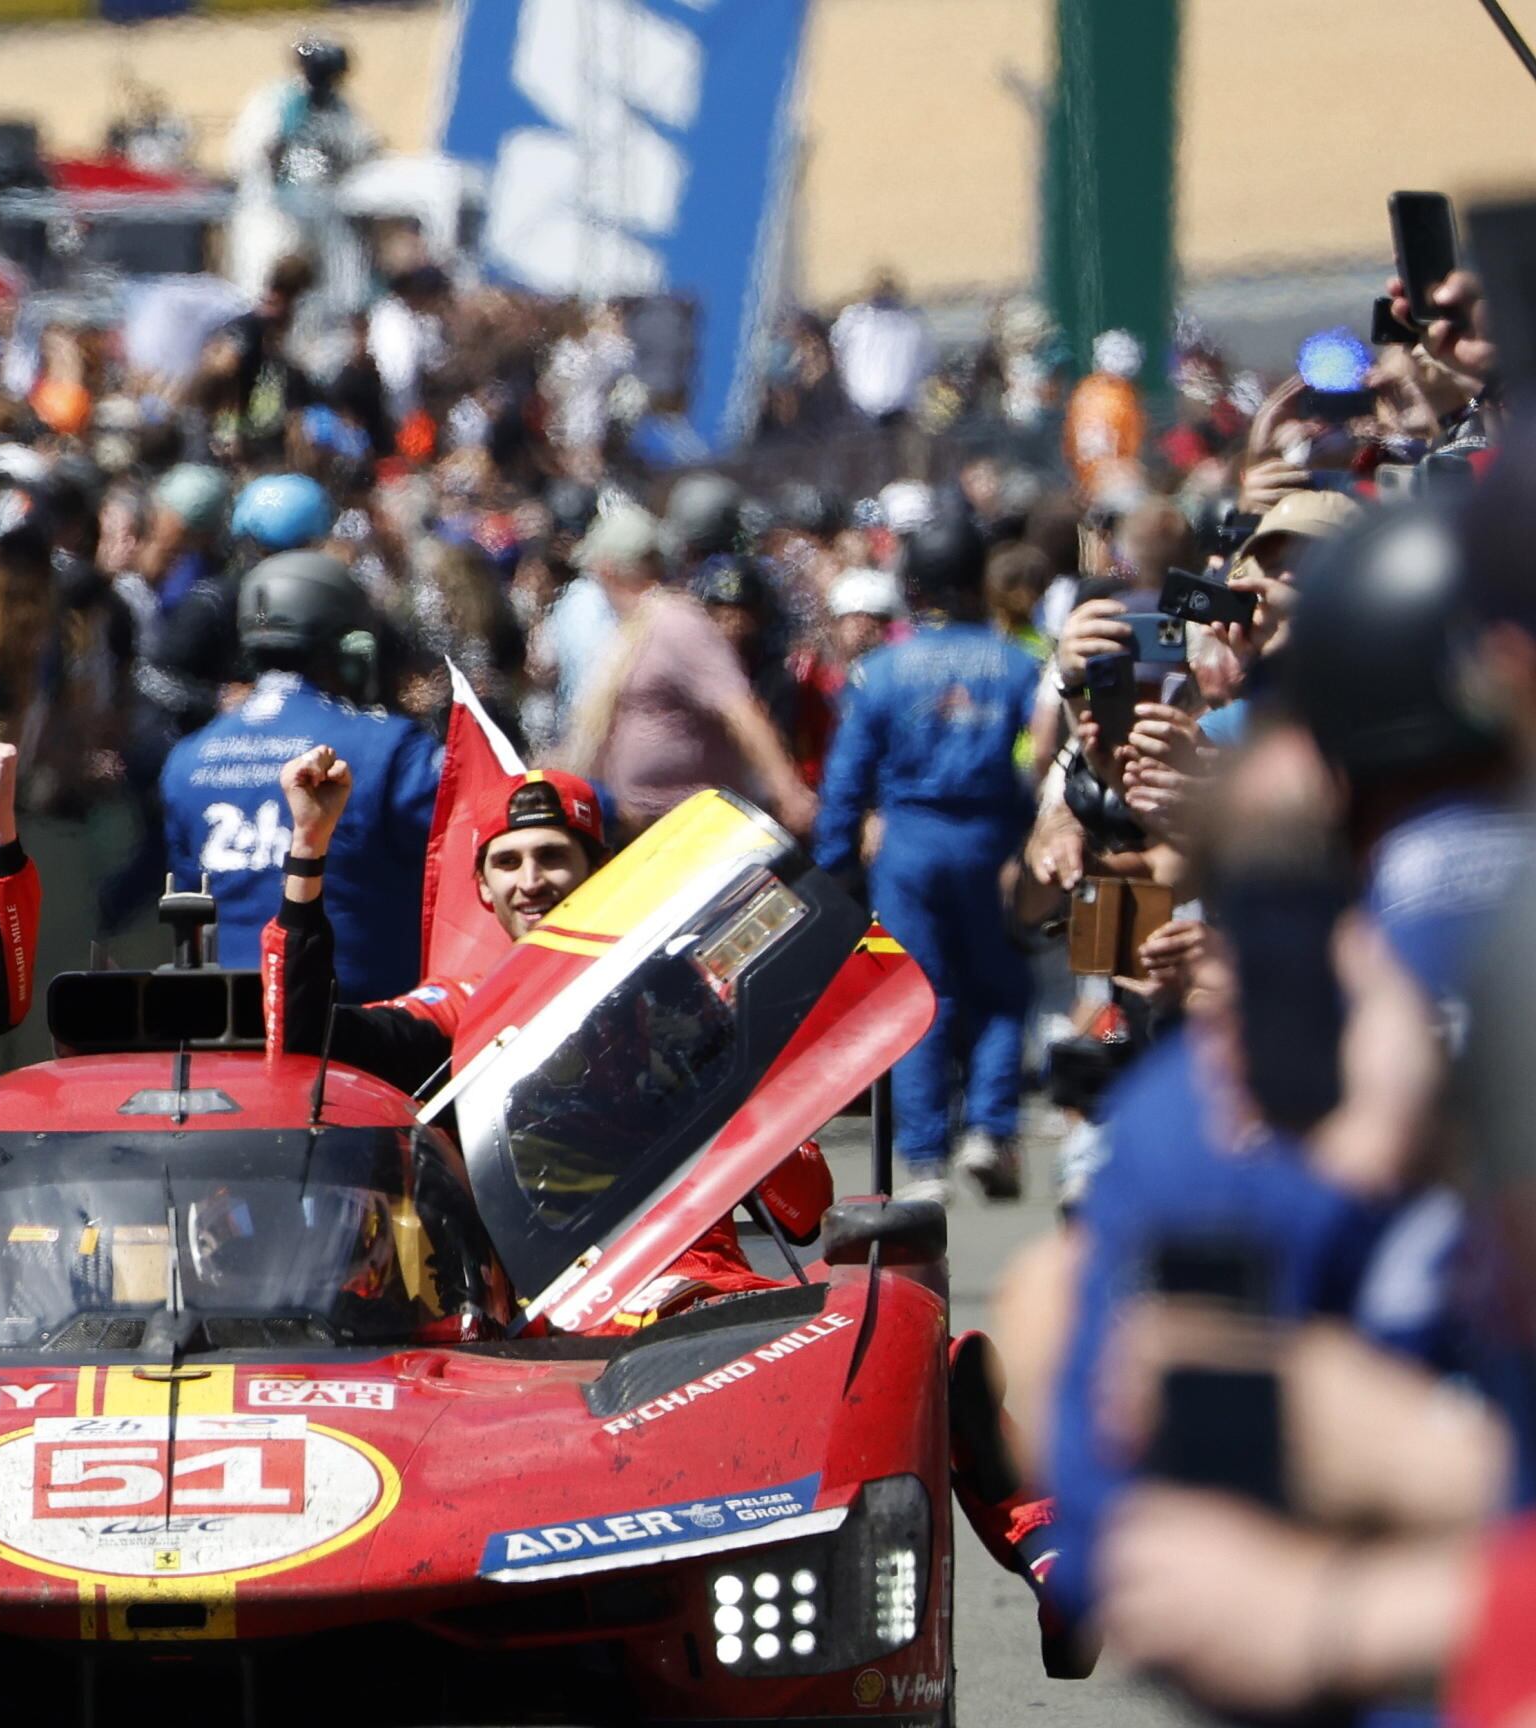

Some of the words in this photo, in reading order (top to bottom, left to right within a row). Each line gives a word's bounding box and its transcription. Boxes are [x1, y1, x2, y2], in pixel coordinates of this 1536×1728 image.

[7, 904, 22, 944] MILLE
[602, 1360, 757, 1435] RICHARD
[754, 1312, 854, 1363] MILLE
[258, 1389, 382, 1406] CAR
[48, 1446, 291, 1508] 51
[724, 1492, 794, 1512] PELZER
[736, 1503, 803, 1521] GROUP
[504, 1510, 683, 1562] ADLER
